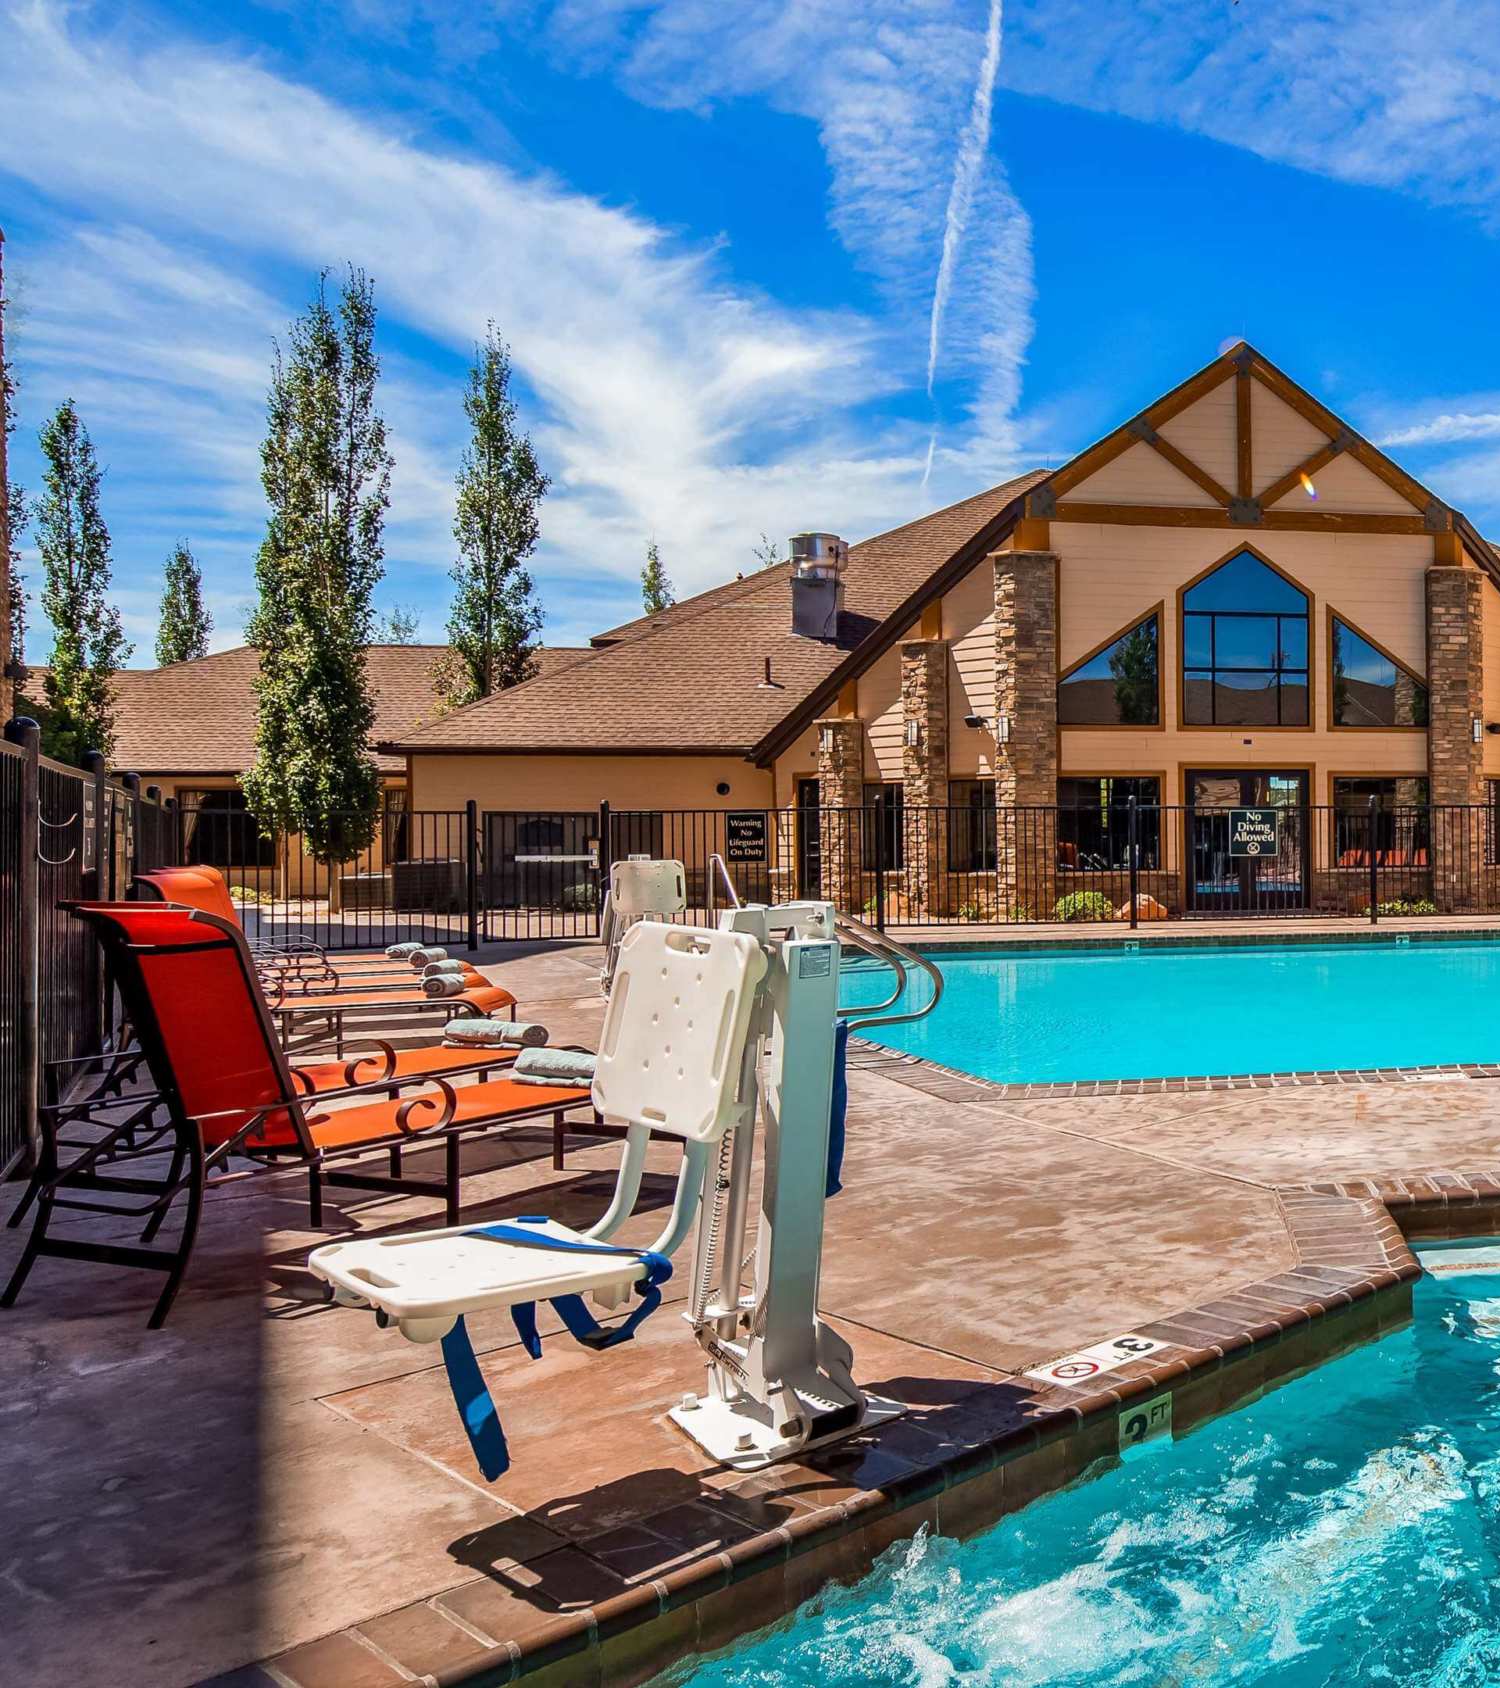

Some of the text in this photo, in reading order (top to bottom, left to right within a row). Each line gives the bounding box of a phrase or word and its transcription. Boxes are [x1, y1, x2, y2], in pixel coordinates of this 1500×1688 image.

[1246, 812, 1261, 821] No
[730, 820, 762, 828] Warning
[1237, 822, 1270, 834] Diving
[1233, 832, 1274, 841] Allowed
[729, 838, 763, 847] Lifeguard
[1112, 1338, 1154, 1352] 3
[1151, 1402, 1167, 1424] FT
